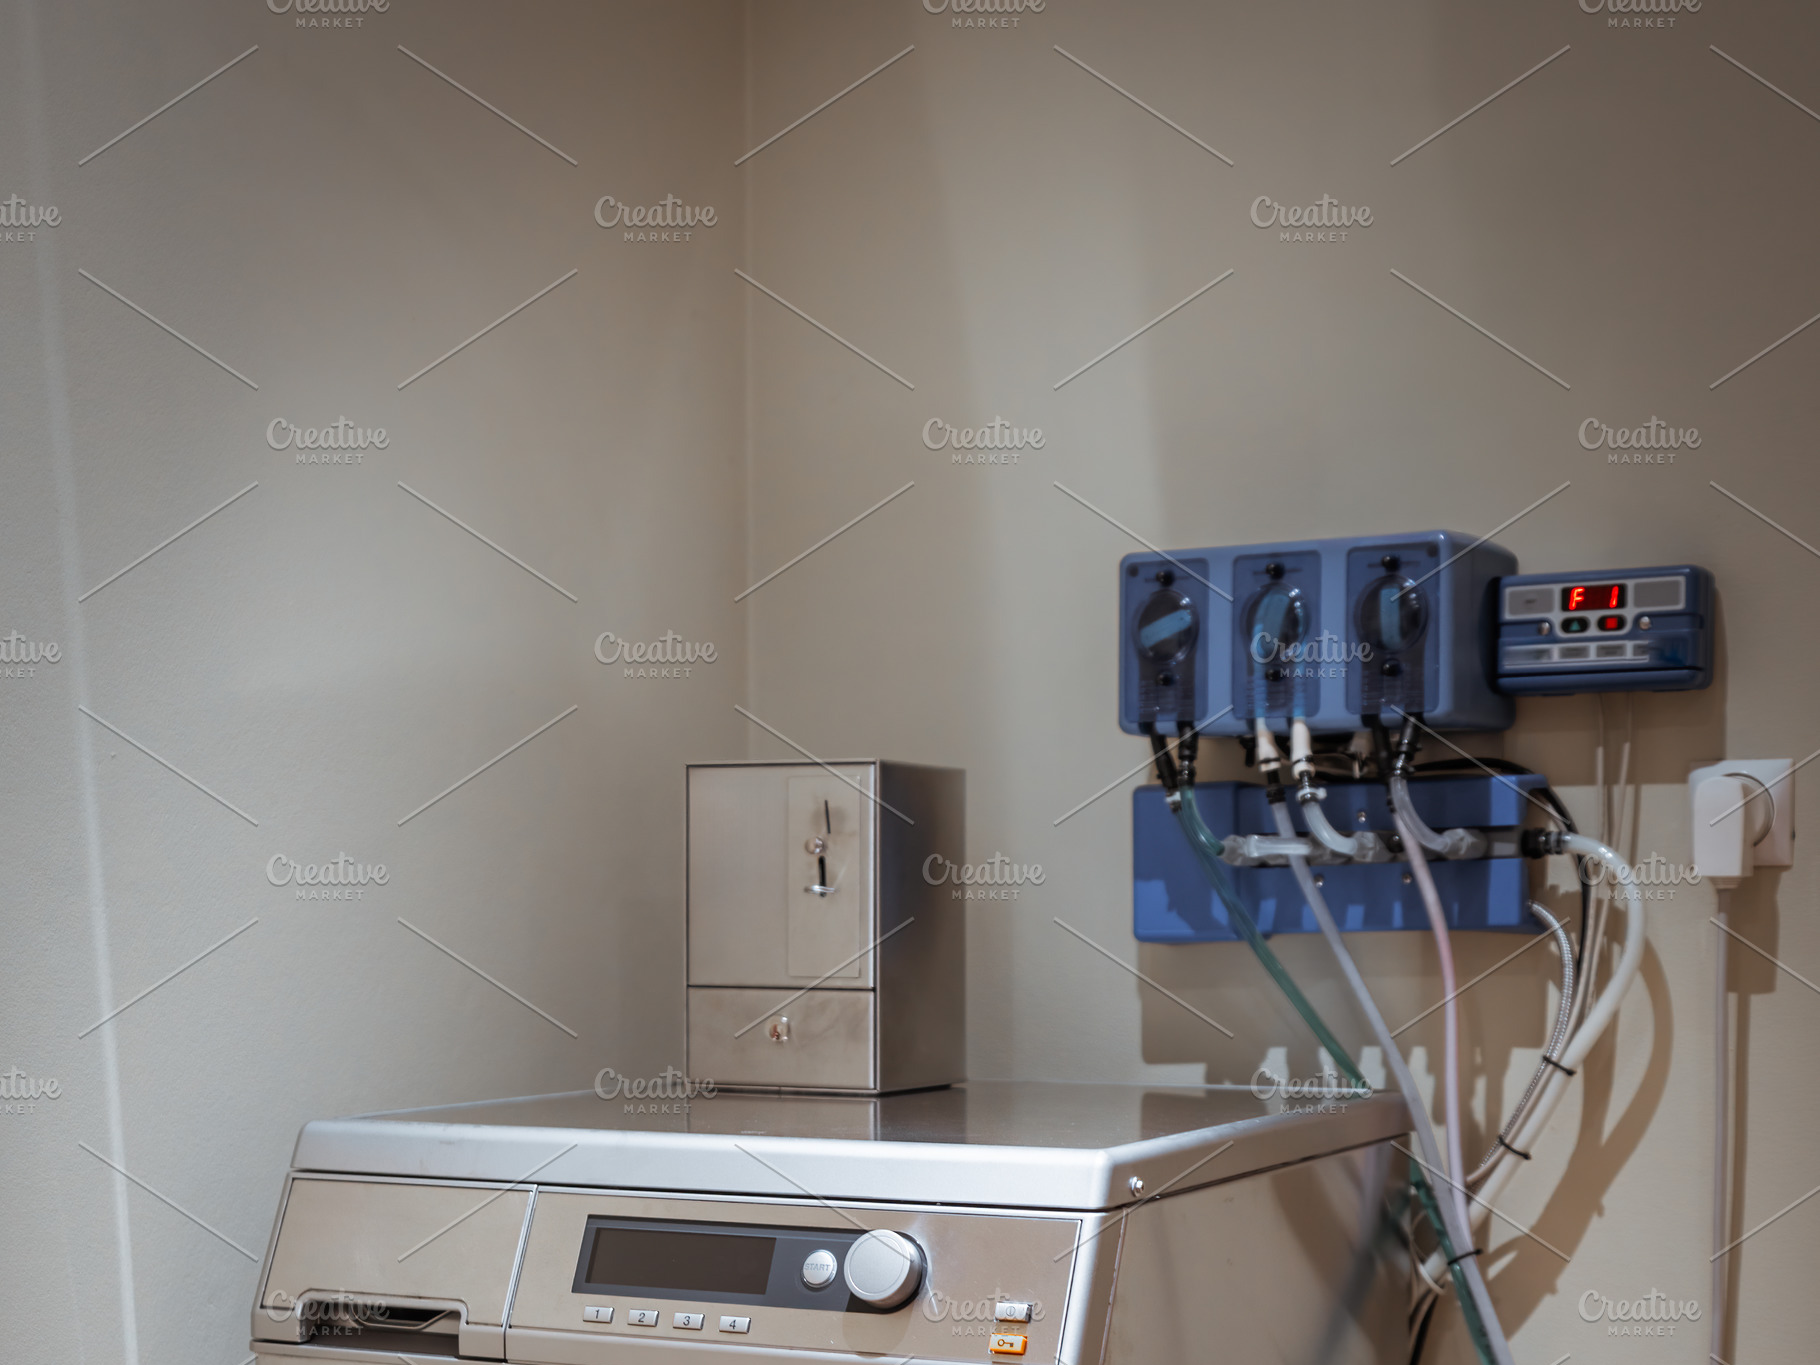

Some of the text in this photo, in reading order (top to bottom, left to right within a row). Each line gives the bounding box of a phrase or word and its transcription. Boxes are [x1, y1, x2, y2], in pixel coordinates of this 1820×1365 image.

[1568, 585, 1619, 610] F 1
[804, 1263, 831, 1271] START
[637, 1312, 646, 1323] 2
[682, 1315, 691, 1326] 3
[728, 1319, 737, 1330] 4
